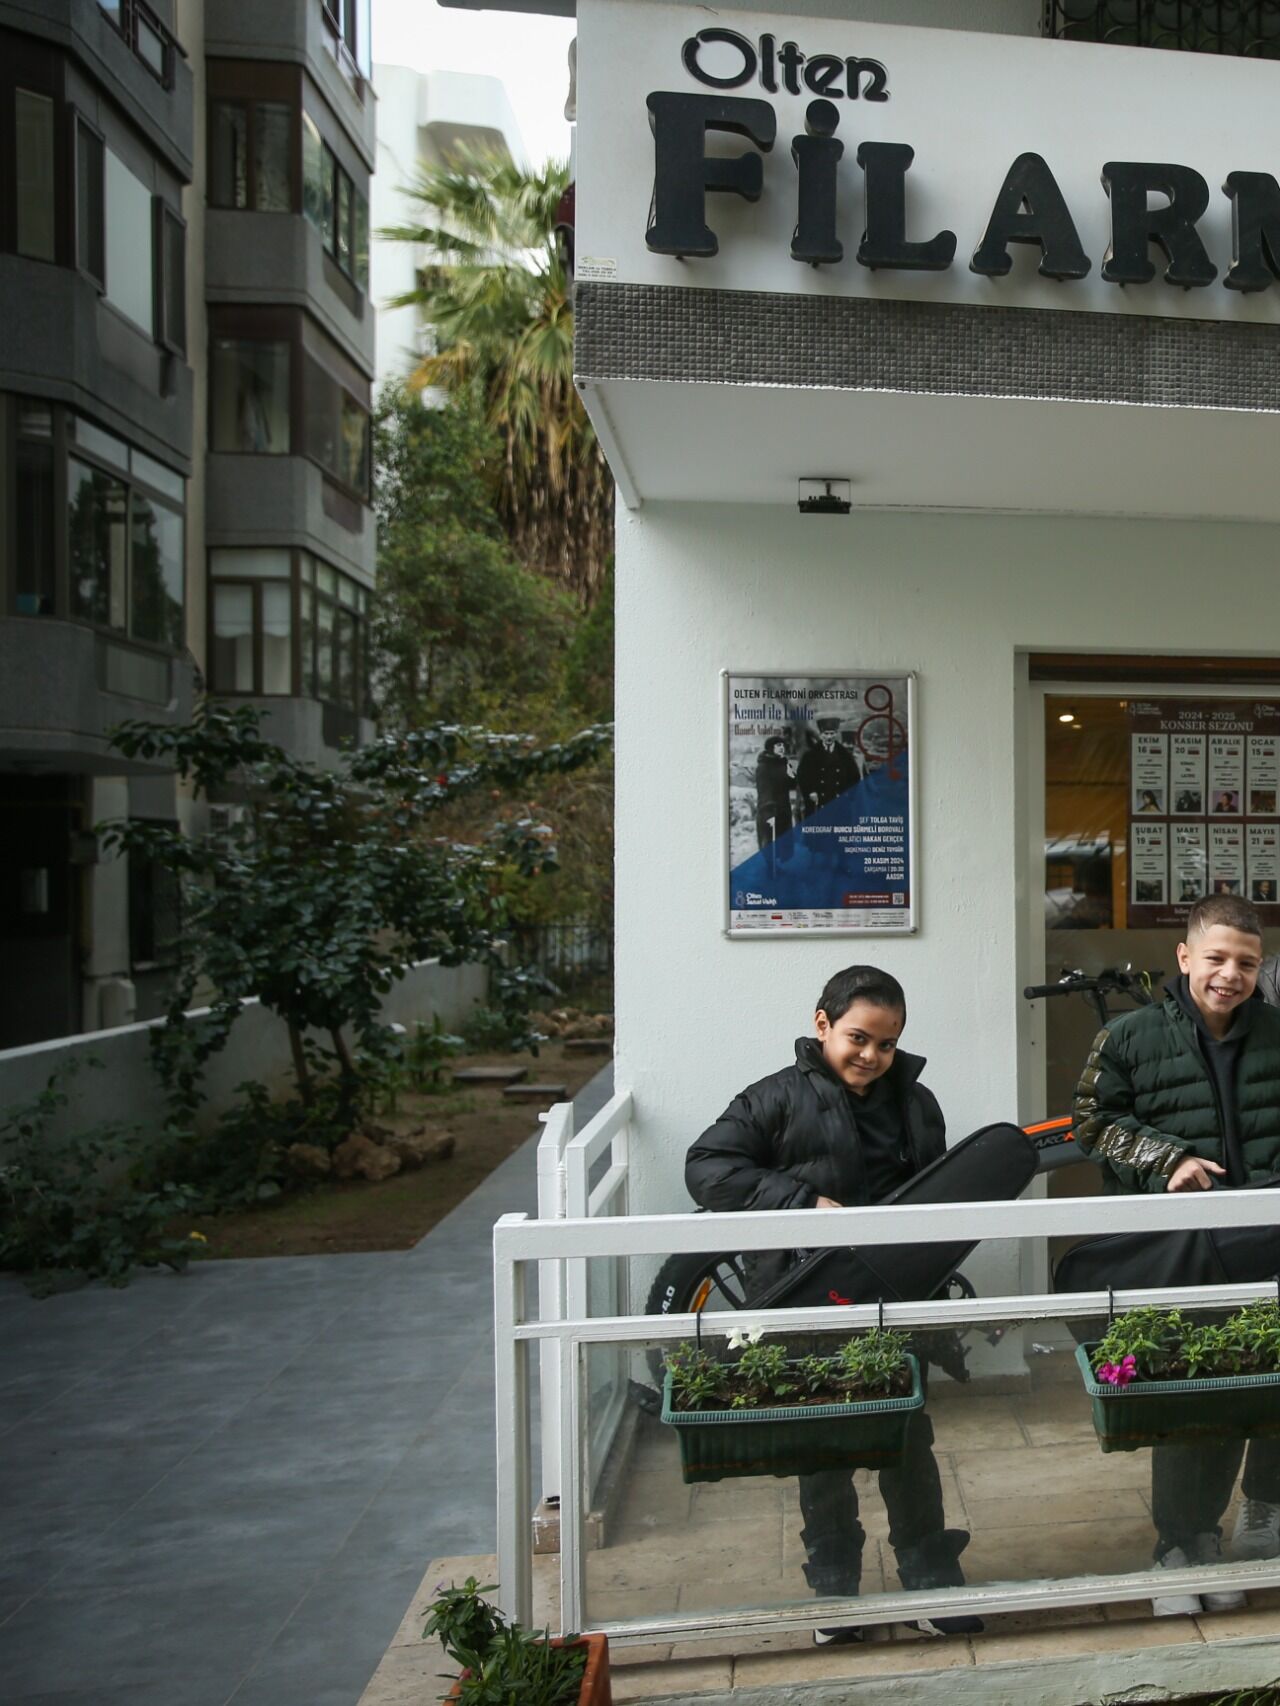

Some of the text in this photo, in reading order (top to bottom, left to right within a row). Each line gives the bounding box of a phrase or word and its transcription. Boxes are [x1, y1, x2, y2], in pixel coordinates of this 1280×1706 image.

[682, 28, 890, 102] Olten
[734, 687, 858, 700] OLTEN FİLARMONİ ORKESTRASI
[1178, 711, 1202, 720] 2024
[1160, 720, 1254, 732] KONSER SEZONU
[1251, 837, 1260, 845] 21
[864, 857, 872, 865] 20
[872, 857, 890, 865] KASIM
[661, 1285, 676, 1315] 4.0
